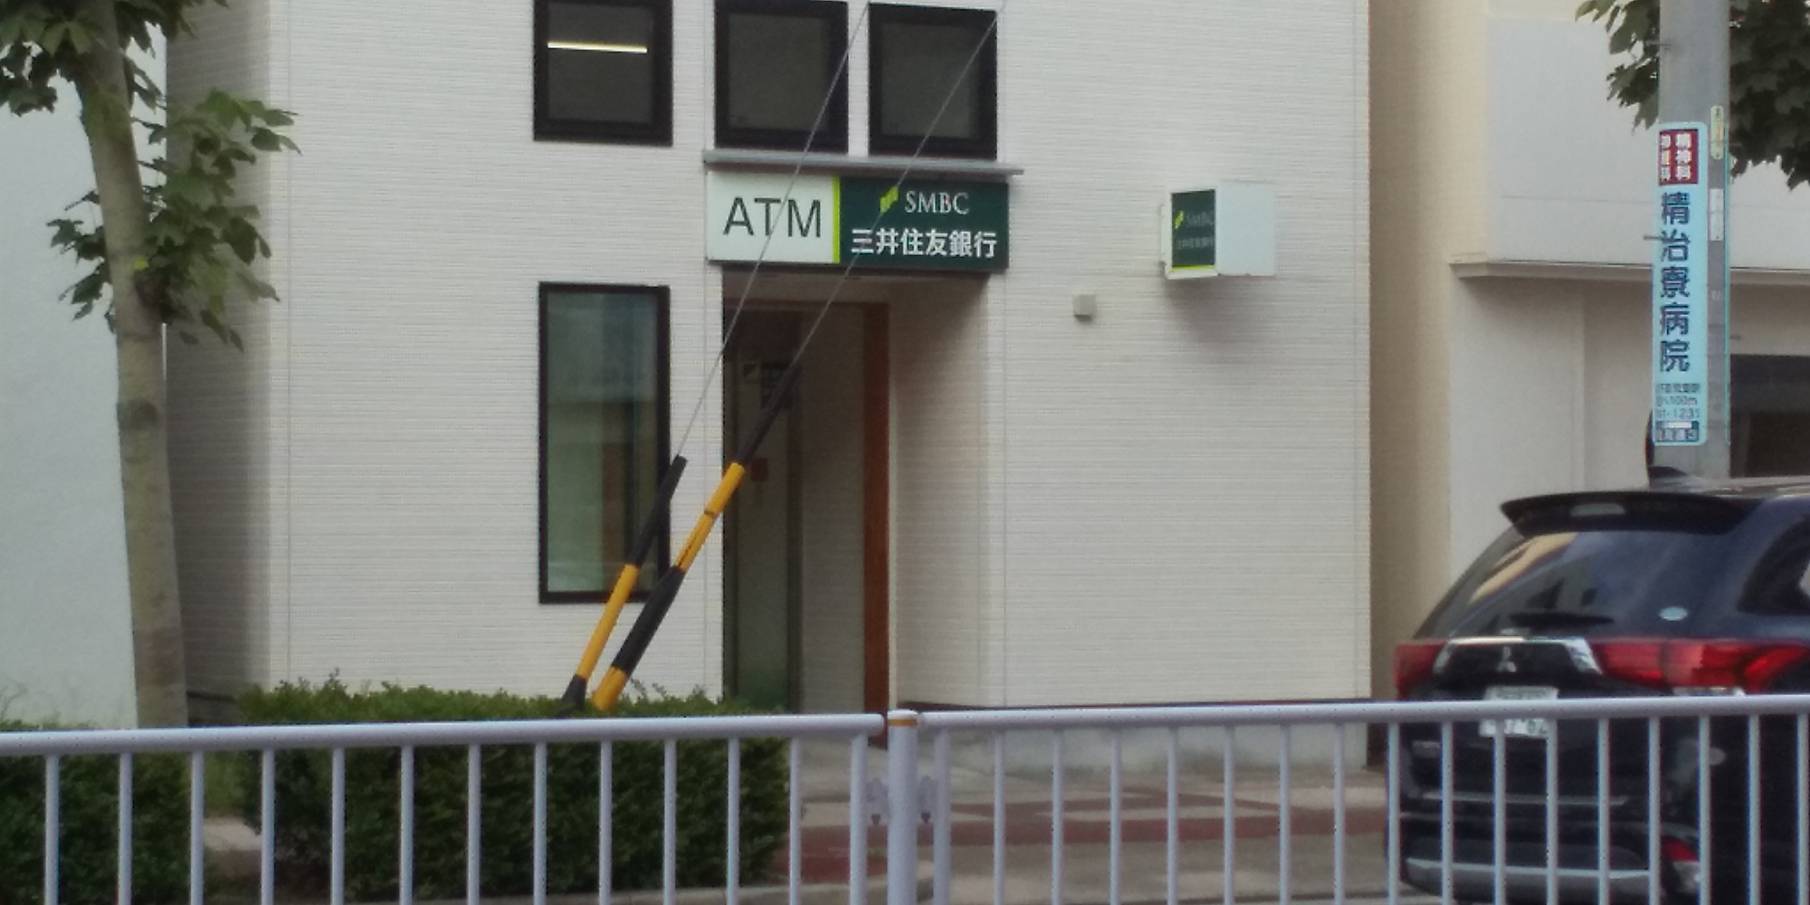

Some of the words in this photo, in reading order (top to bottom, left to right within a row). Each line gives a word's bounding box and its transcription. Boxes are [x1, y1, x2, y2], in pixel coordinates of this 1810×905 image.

[722, 196, 822, 238] ATM
[904, 190, 969, 215] SMBC
[851, 228, 998, 259] 三井住友銀行
